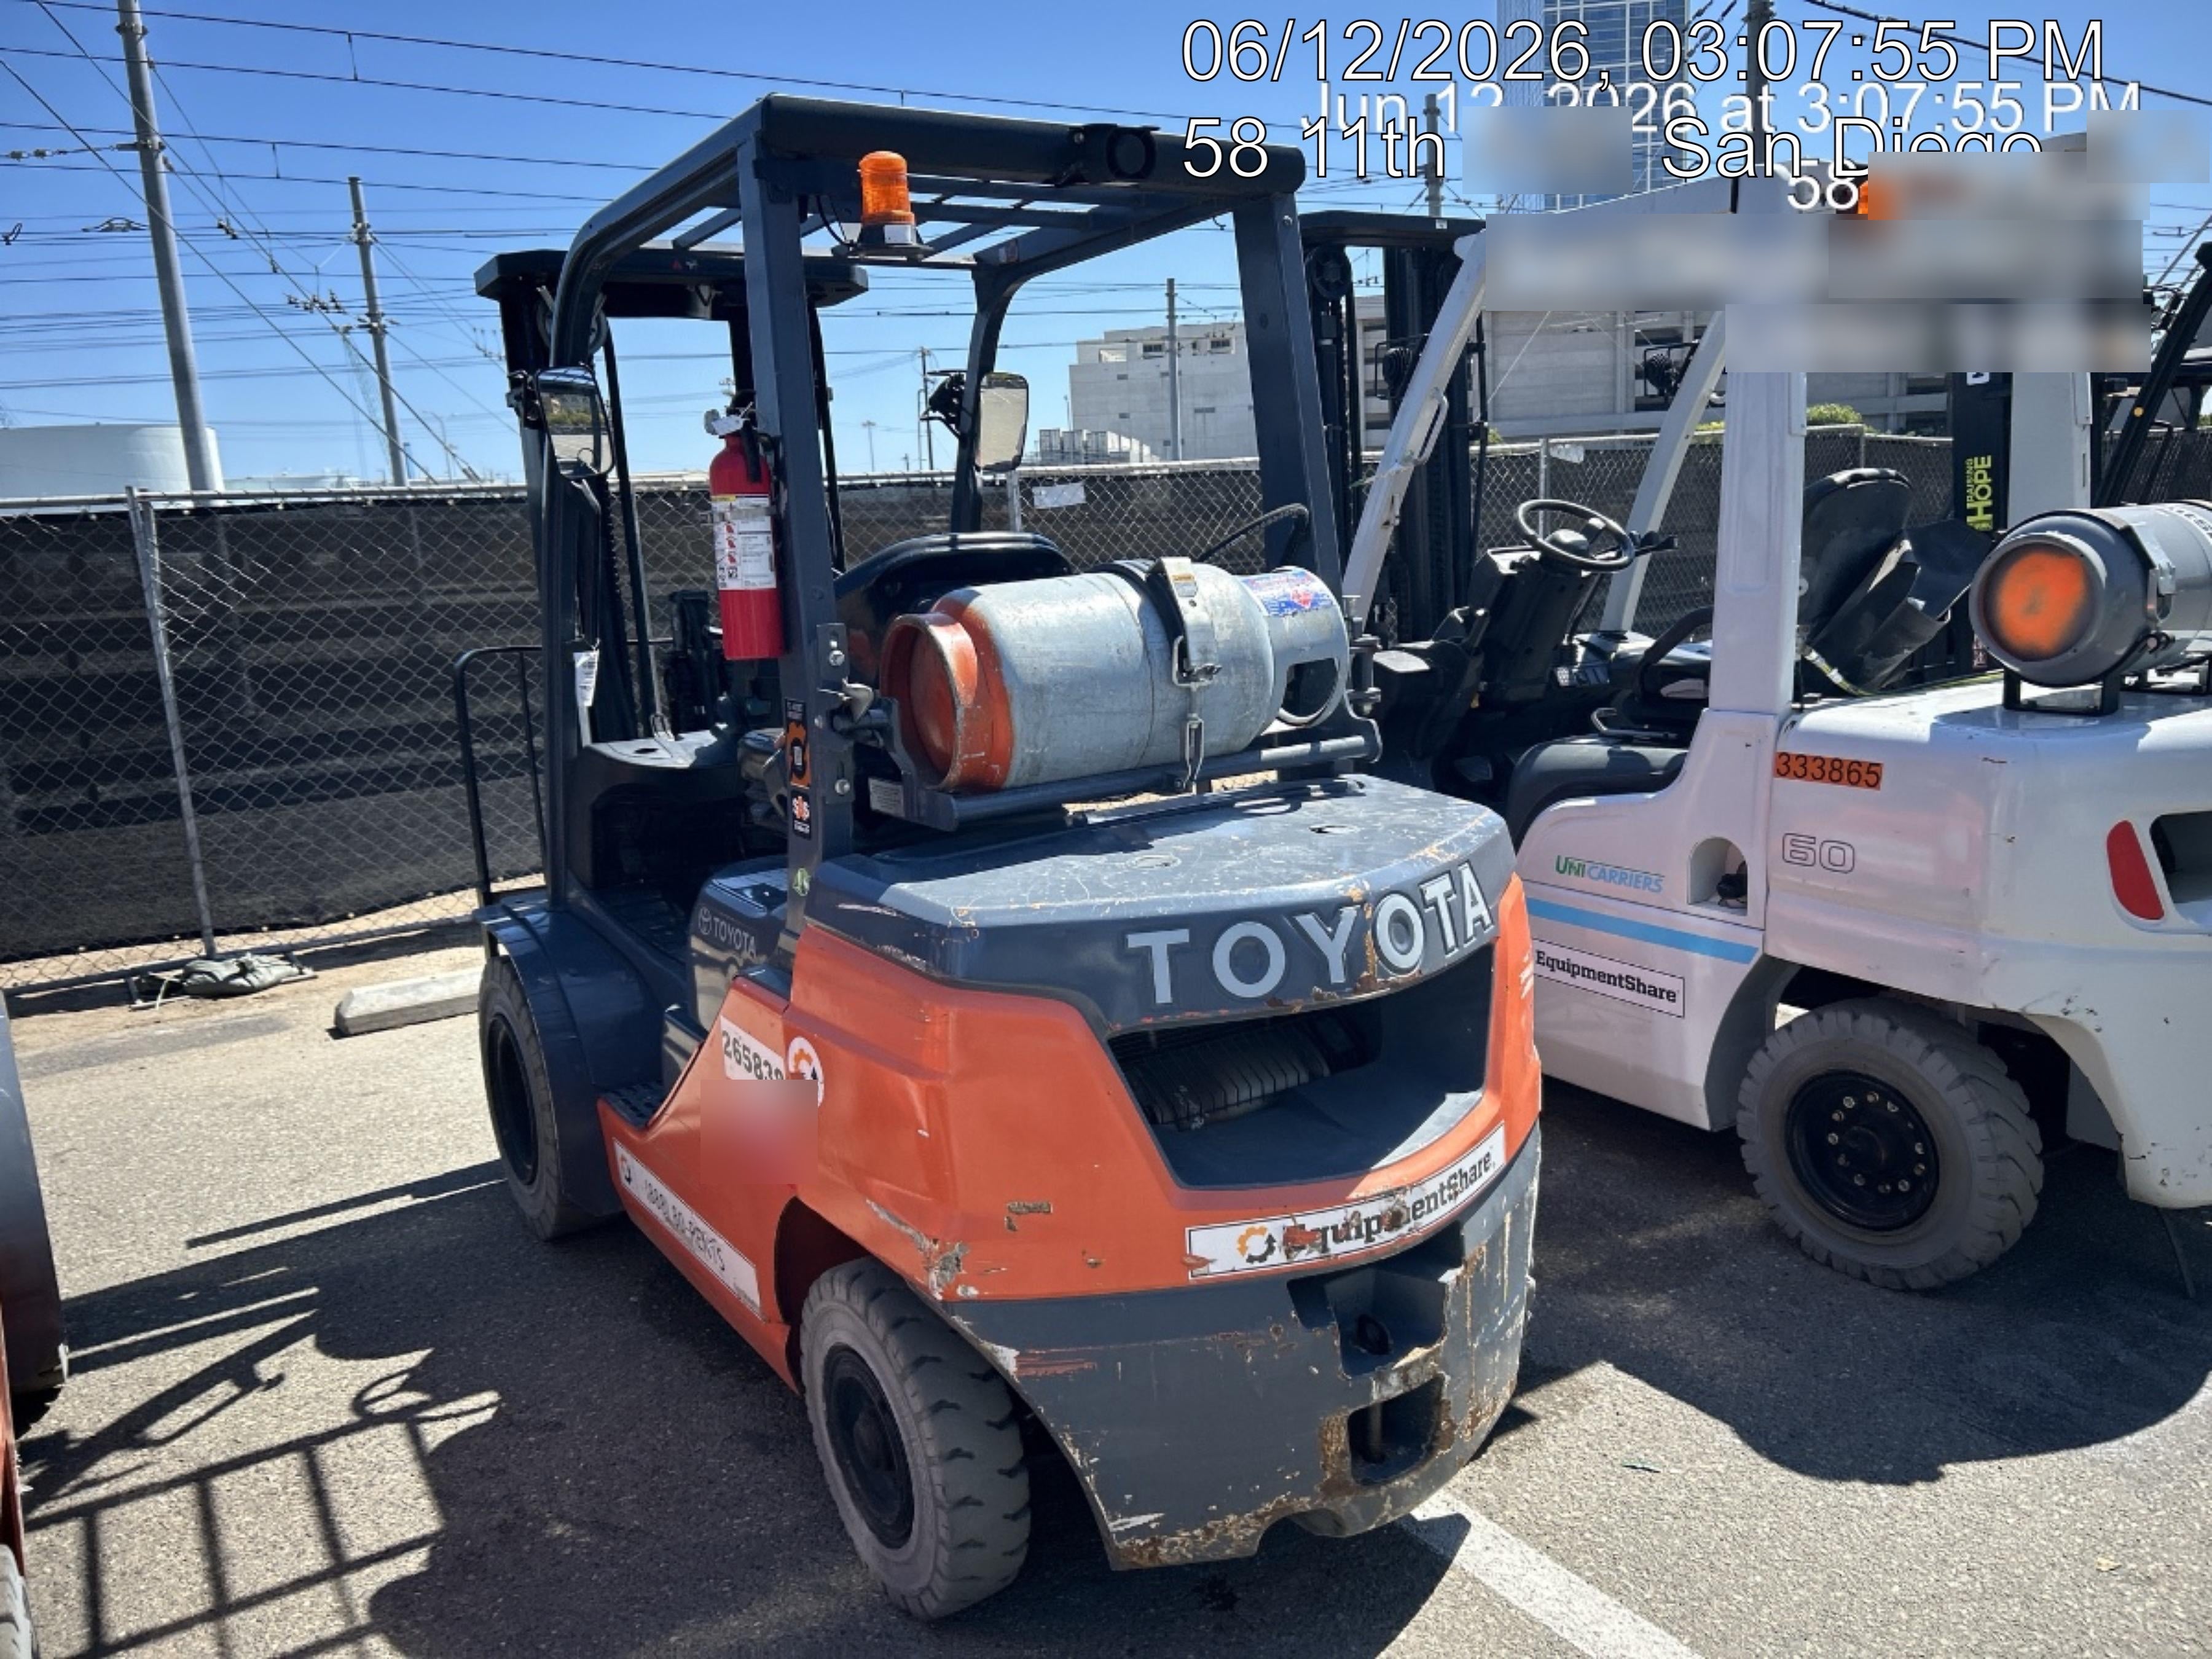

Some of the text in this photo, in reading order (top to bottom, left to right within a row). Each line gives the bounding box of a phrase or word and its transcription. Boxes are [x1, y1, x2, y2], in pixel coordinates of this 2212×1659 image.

[1966, 454, 1993, 523] HOPE
[1776, 751, 1883, 788] 333865
[1782, 832, 1855, 874] 60
[713, 917, 757, 959] TOYOTA
[1127, 860, 1494, 1005] TOYOTA
[1535, 949, 1677, 1003] EquipmentShare
[1283, 1151, 1492, 1258] quipentShare
